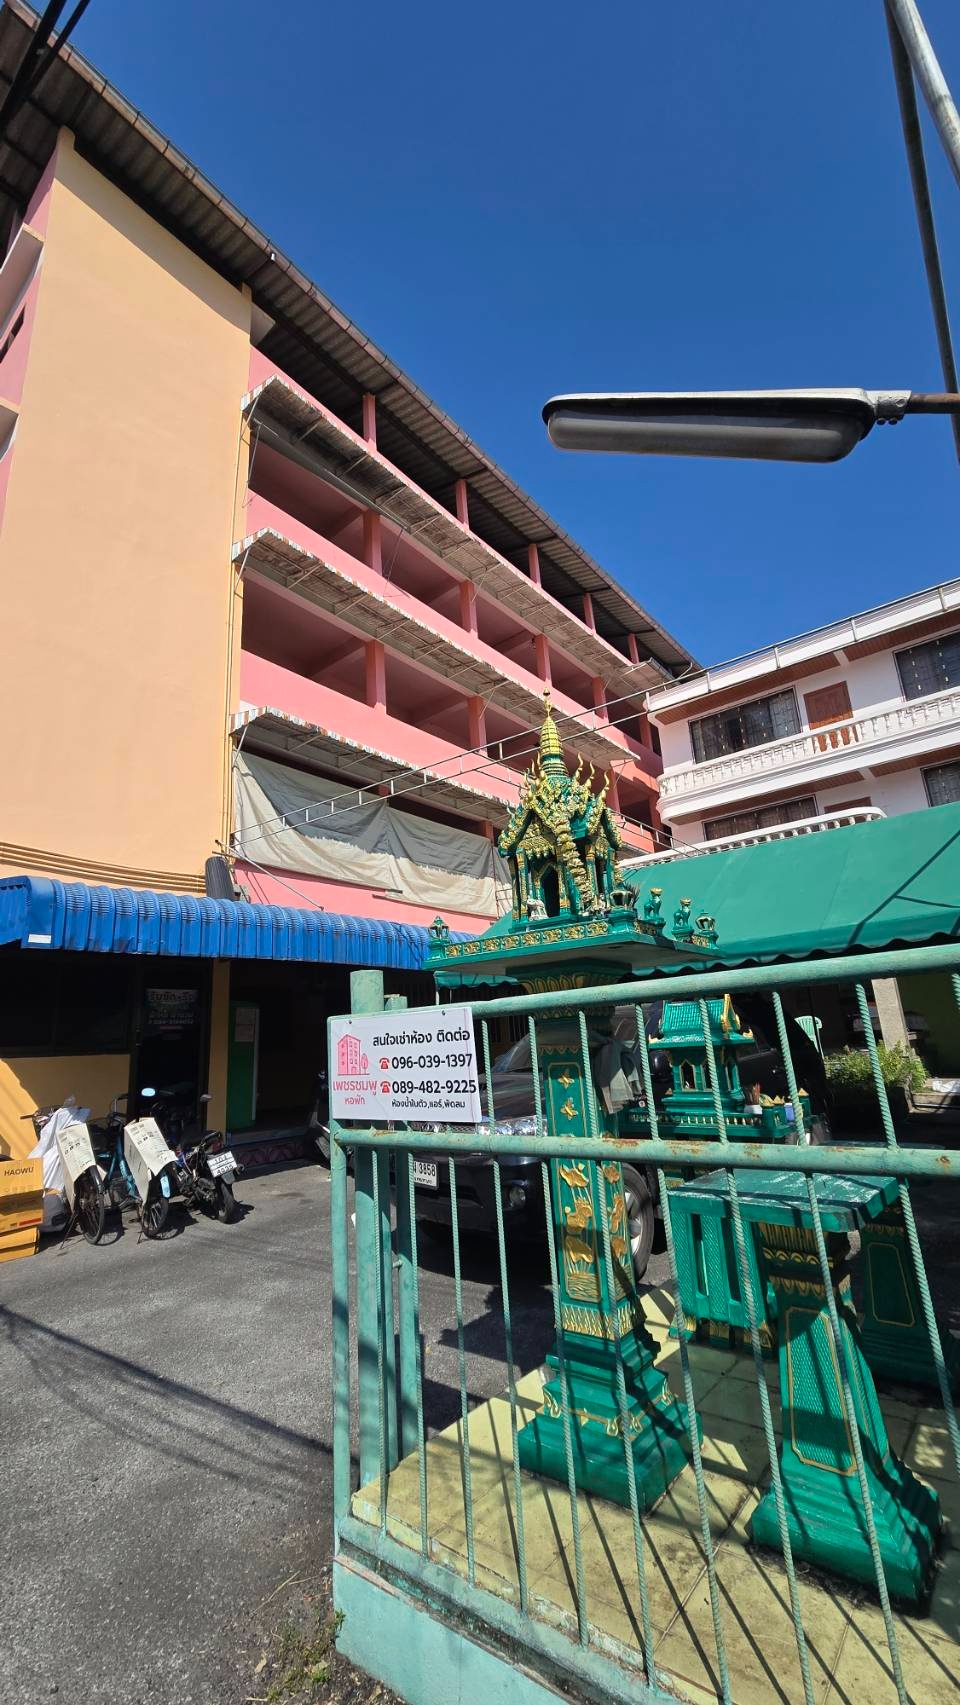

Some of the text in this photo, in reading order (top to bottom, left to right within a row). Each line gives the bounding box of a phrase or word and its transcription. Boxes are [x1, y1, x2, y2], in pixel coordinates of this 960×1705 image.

[372, 1027, 471, 1047] สนใจเช่าห้อง ติดต่อ
[391, 1053, 473, 1069] 096-039-1397
[333, 1080, 378, 1096] เพชรชมพู
[391, 1079, 477, 1094] 089-482-9225
[344, 1094, 366, 1105] หอพัก
[3, 1166, 34, 1176] HAOWU
